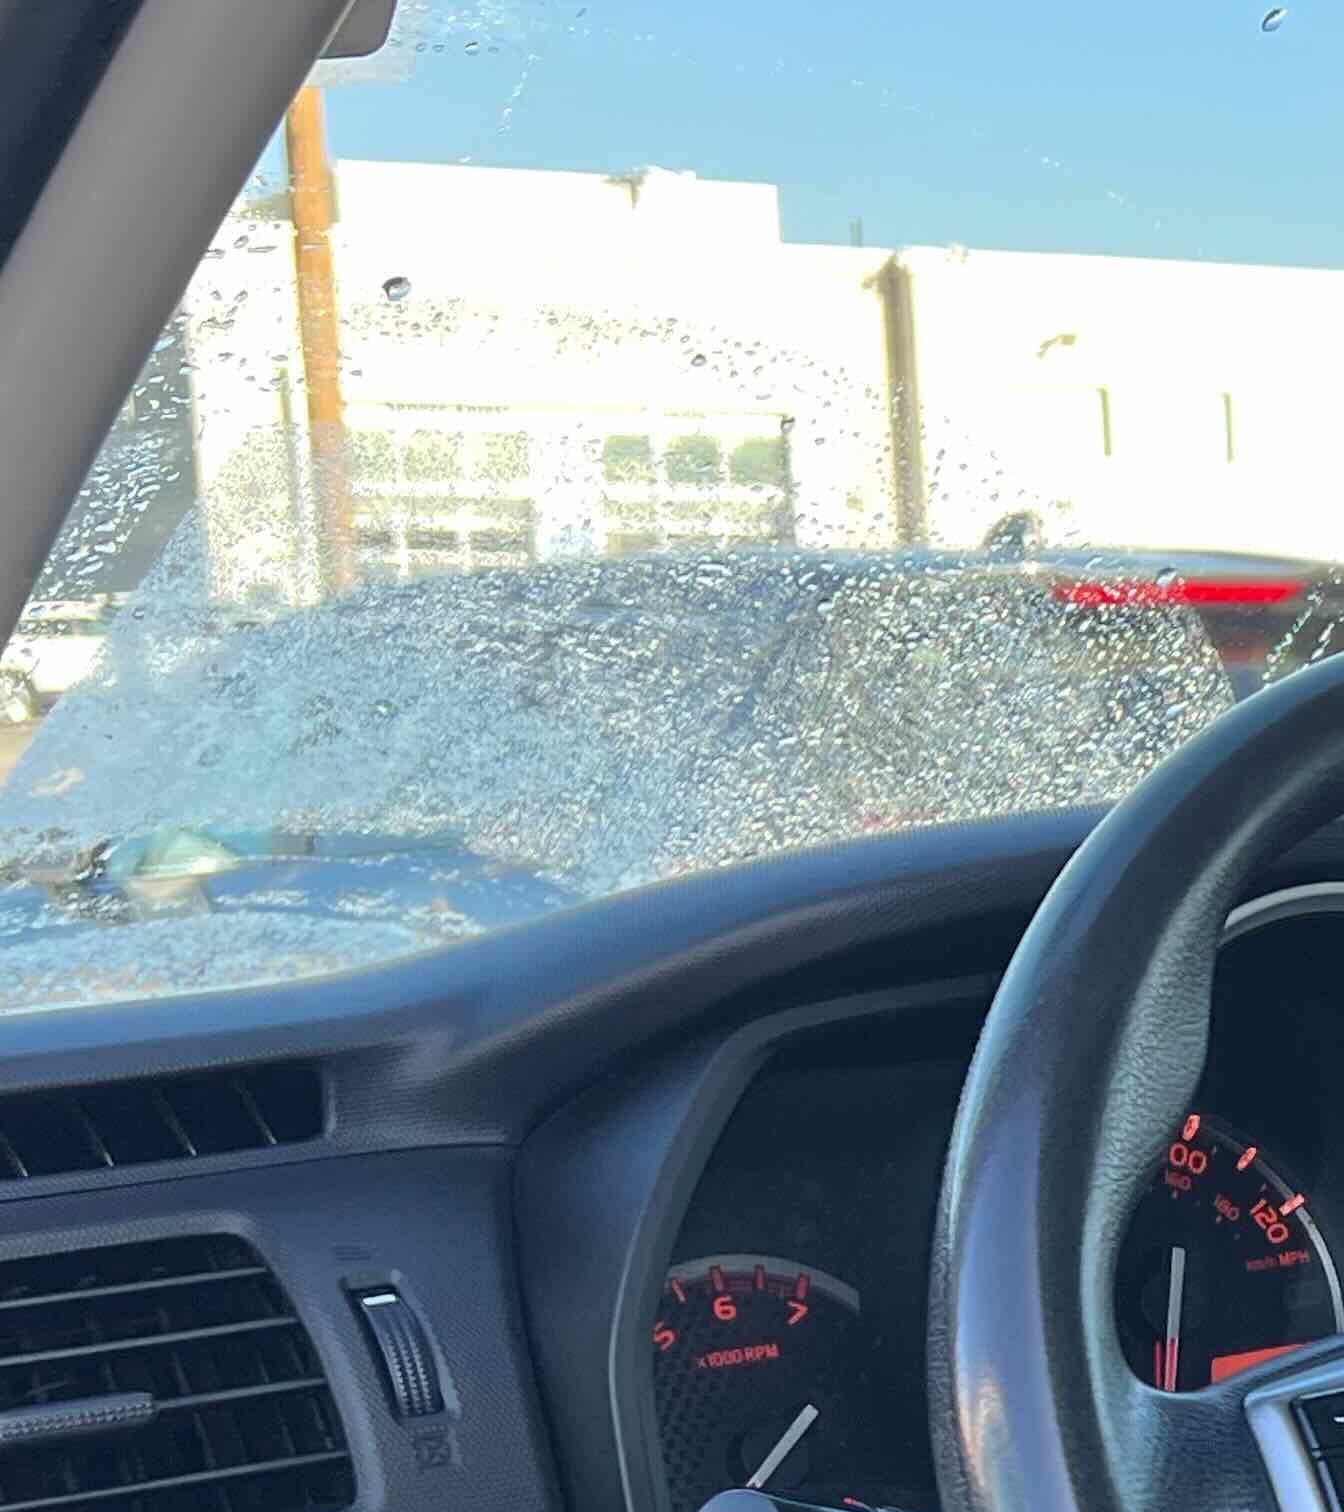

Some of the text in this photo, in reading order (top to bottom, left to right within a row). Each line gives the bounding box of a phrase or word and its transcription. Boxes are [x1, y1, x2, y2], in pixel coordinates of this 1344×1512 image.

[1168, 1142, 1208, 1175] 00
[1250, 1198, 1289, 1244] 120
[713, 1295, 737, 1321] 6
[786, 1300, 809, 1326] 7
[653, 1320, 677, 1351] 5
